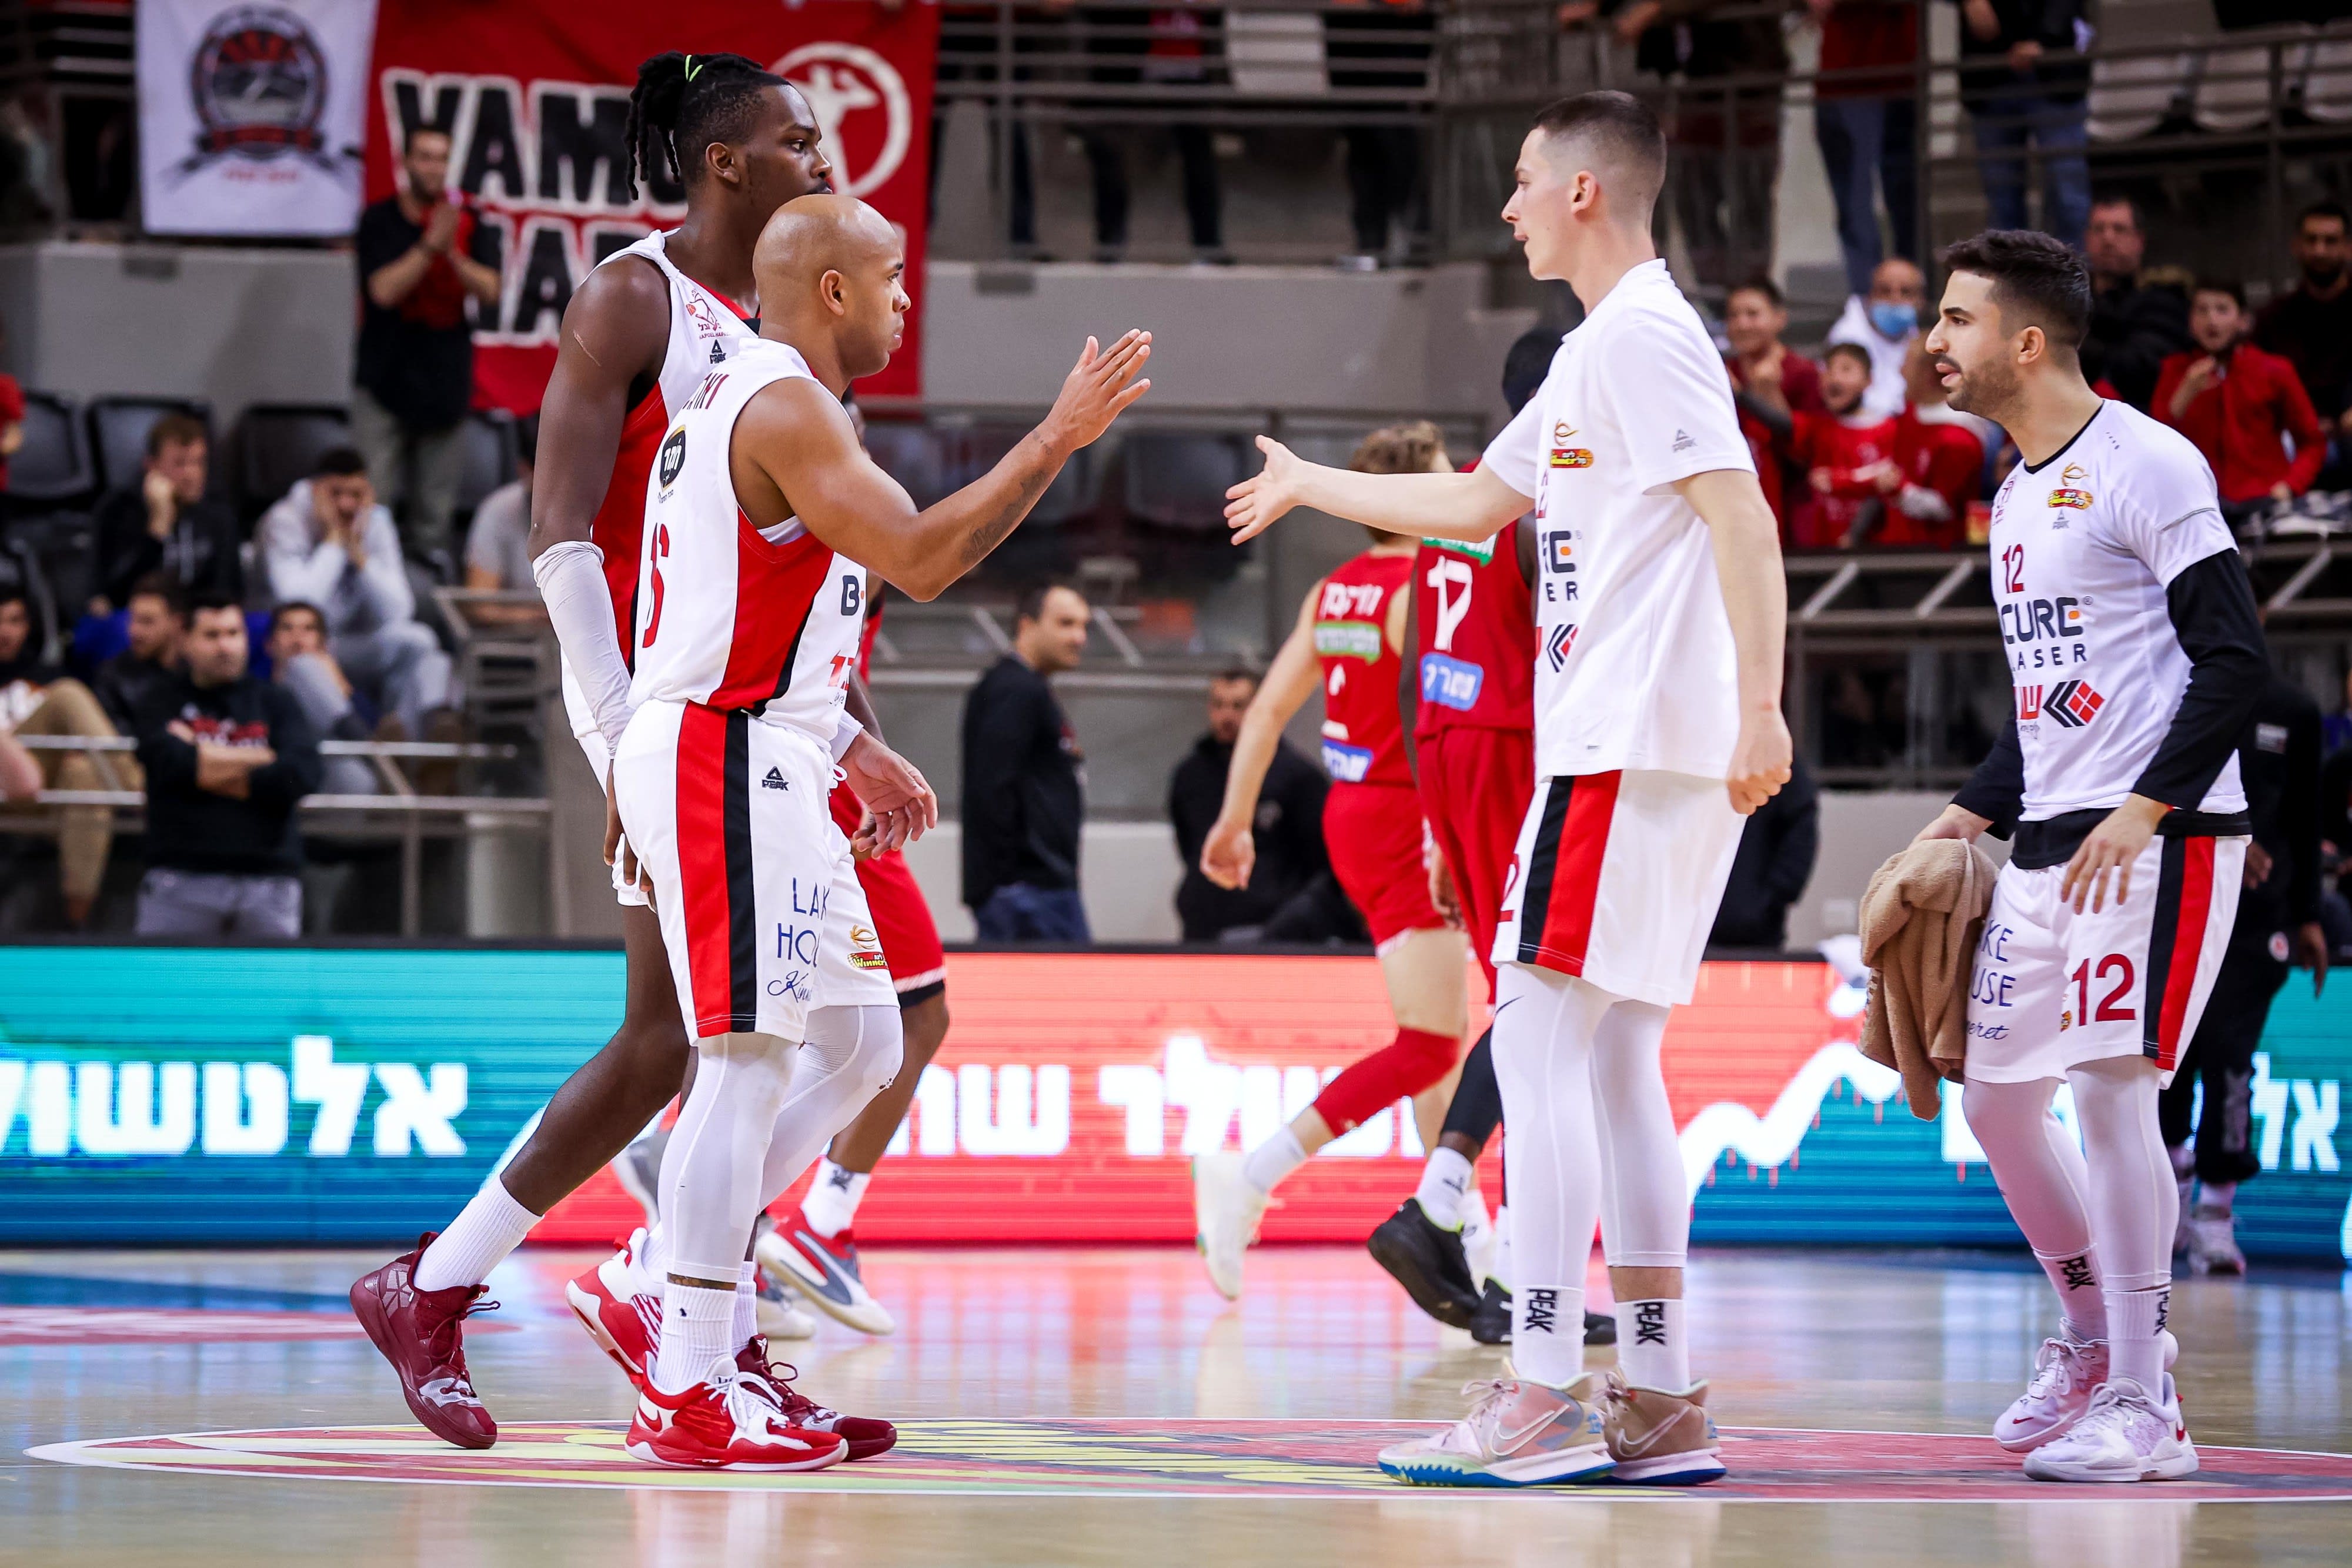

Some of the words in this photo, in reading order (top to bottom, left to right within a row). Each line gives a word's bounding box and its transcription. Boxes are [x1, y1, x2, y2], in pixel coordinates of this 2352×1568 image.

[2001, 544, 2025, 593] 12
[2012, 643, 2087, 672] ASER
[761, 780, 789, 791] PEAK
[2072, 954, 2136, 1027] 12
[2250, 1051, 2340, 1171] אל
[2057, 1255, 2096, 1291] PEAK
[1524, 1288, 1559, 1334] PEAK
[1634, 1302, 1668, 1346] PEAK
